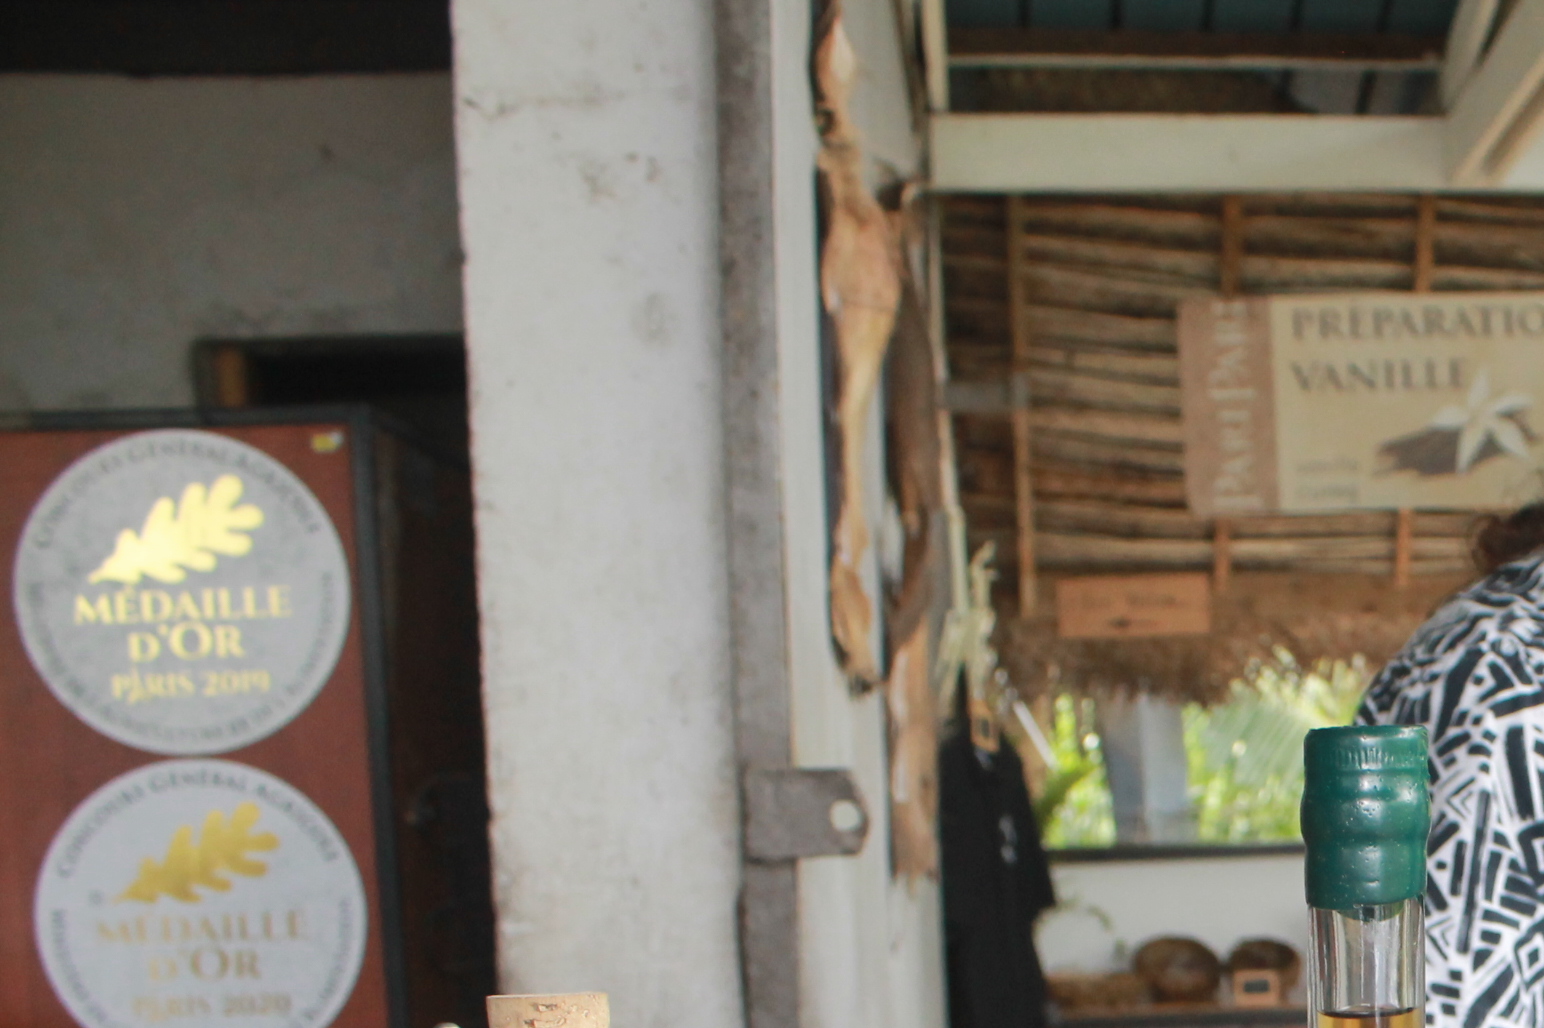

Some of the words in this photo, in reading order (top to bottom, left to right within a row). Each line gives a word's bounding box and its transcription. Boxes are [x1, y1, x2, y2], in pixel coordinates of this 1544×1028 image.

[1291, 357, 1469, 393] VANILLE
[74, 584, 293, 625] MÉDAILLE
[204, 668, 271, 696] 2019
